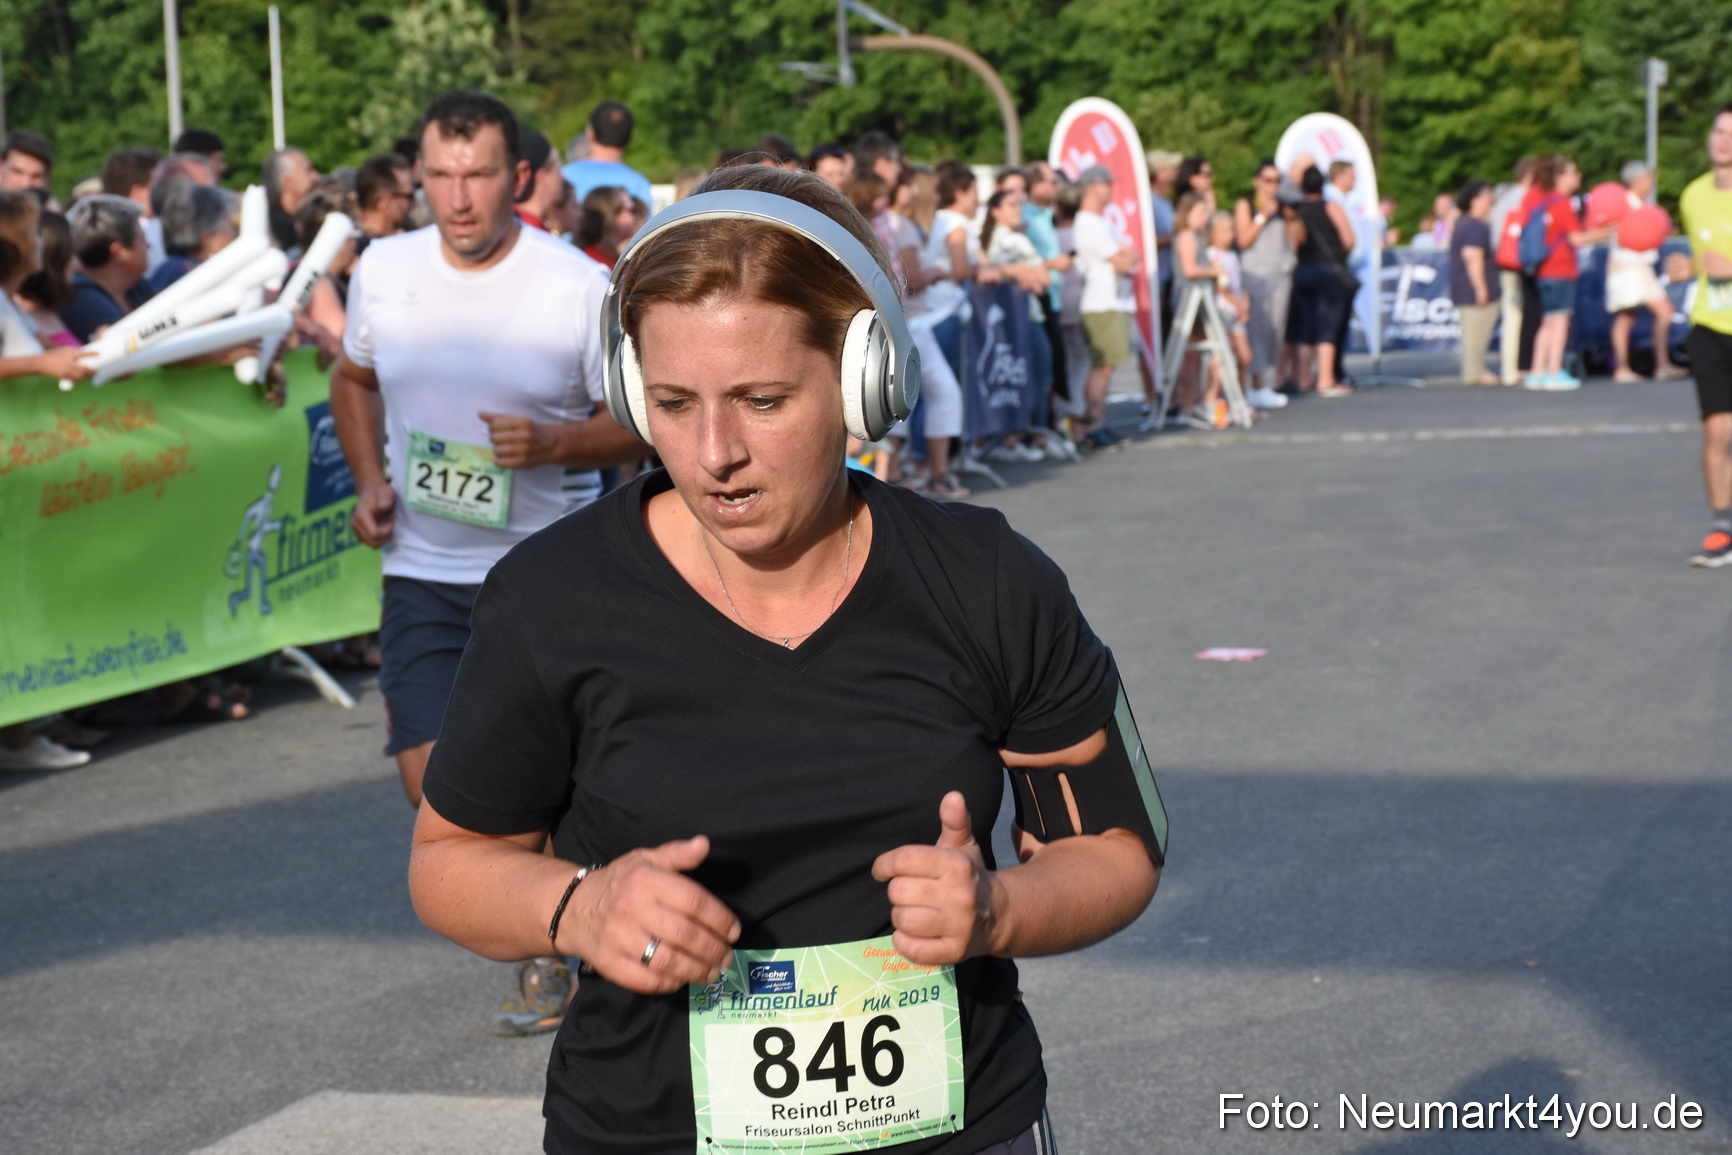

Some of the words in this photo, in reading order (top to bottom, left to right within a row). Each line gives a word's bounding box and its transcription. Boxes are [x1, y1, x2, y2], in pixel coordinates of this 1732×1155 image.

[415, 462, 494, 503] 2172
[731, 985, 839, 1011] firmenlauf
[862, 994, 891, 1012] run
[898, 985, 940, 1007] 2019
[731, 1009, 777, 1019] neumarkt
[753, 1014, 905, 1099] 846
[771, 1099, 838, 1121] Reindl
[845, 1094, 896, 1115] Petra
[745, 1123, 832, 1138] Friseursalon
[837, 1108, 921, 1132] SchnittPunkt
